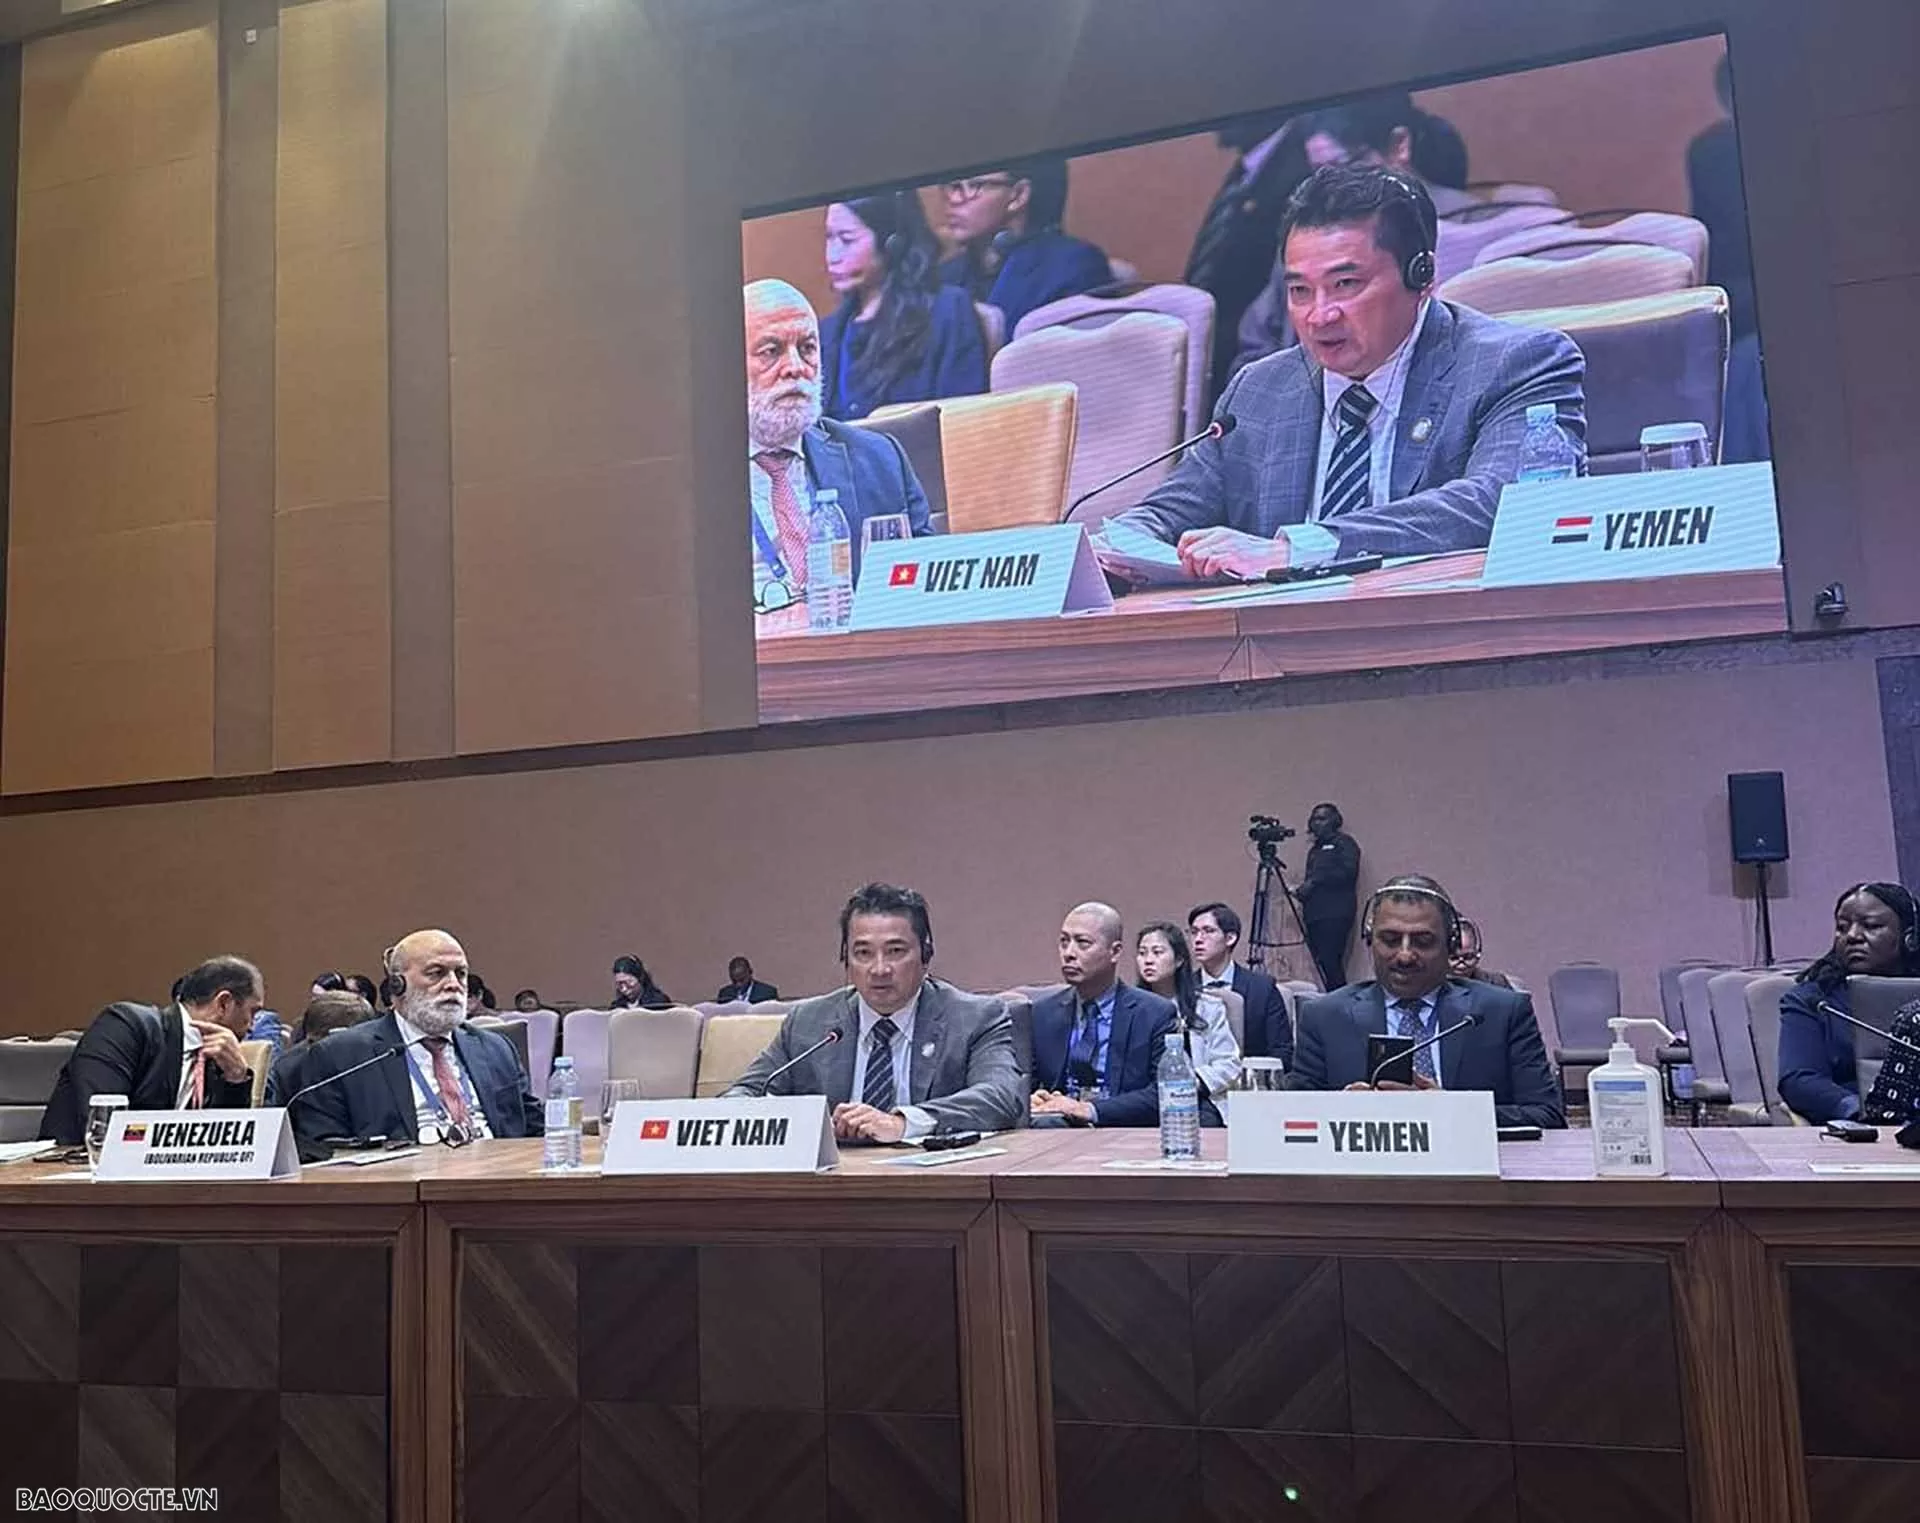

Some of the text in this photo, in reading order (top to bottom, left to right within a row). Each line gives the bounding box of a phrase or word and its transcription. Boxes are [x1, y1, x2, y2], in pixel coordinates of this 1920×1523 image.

[1604, 506, 1714, 550] YEMEN
[925, 553, 1040, 592] VIET NAM
[151, 1120, 255, 1147] VENEZUELA
[677, 1118, 789, 1146] VIET NAM
[1328, 1121, 1430, 1152] YEMEN
[198, 1152, 239, 1163] REPUBLIC
